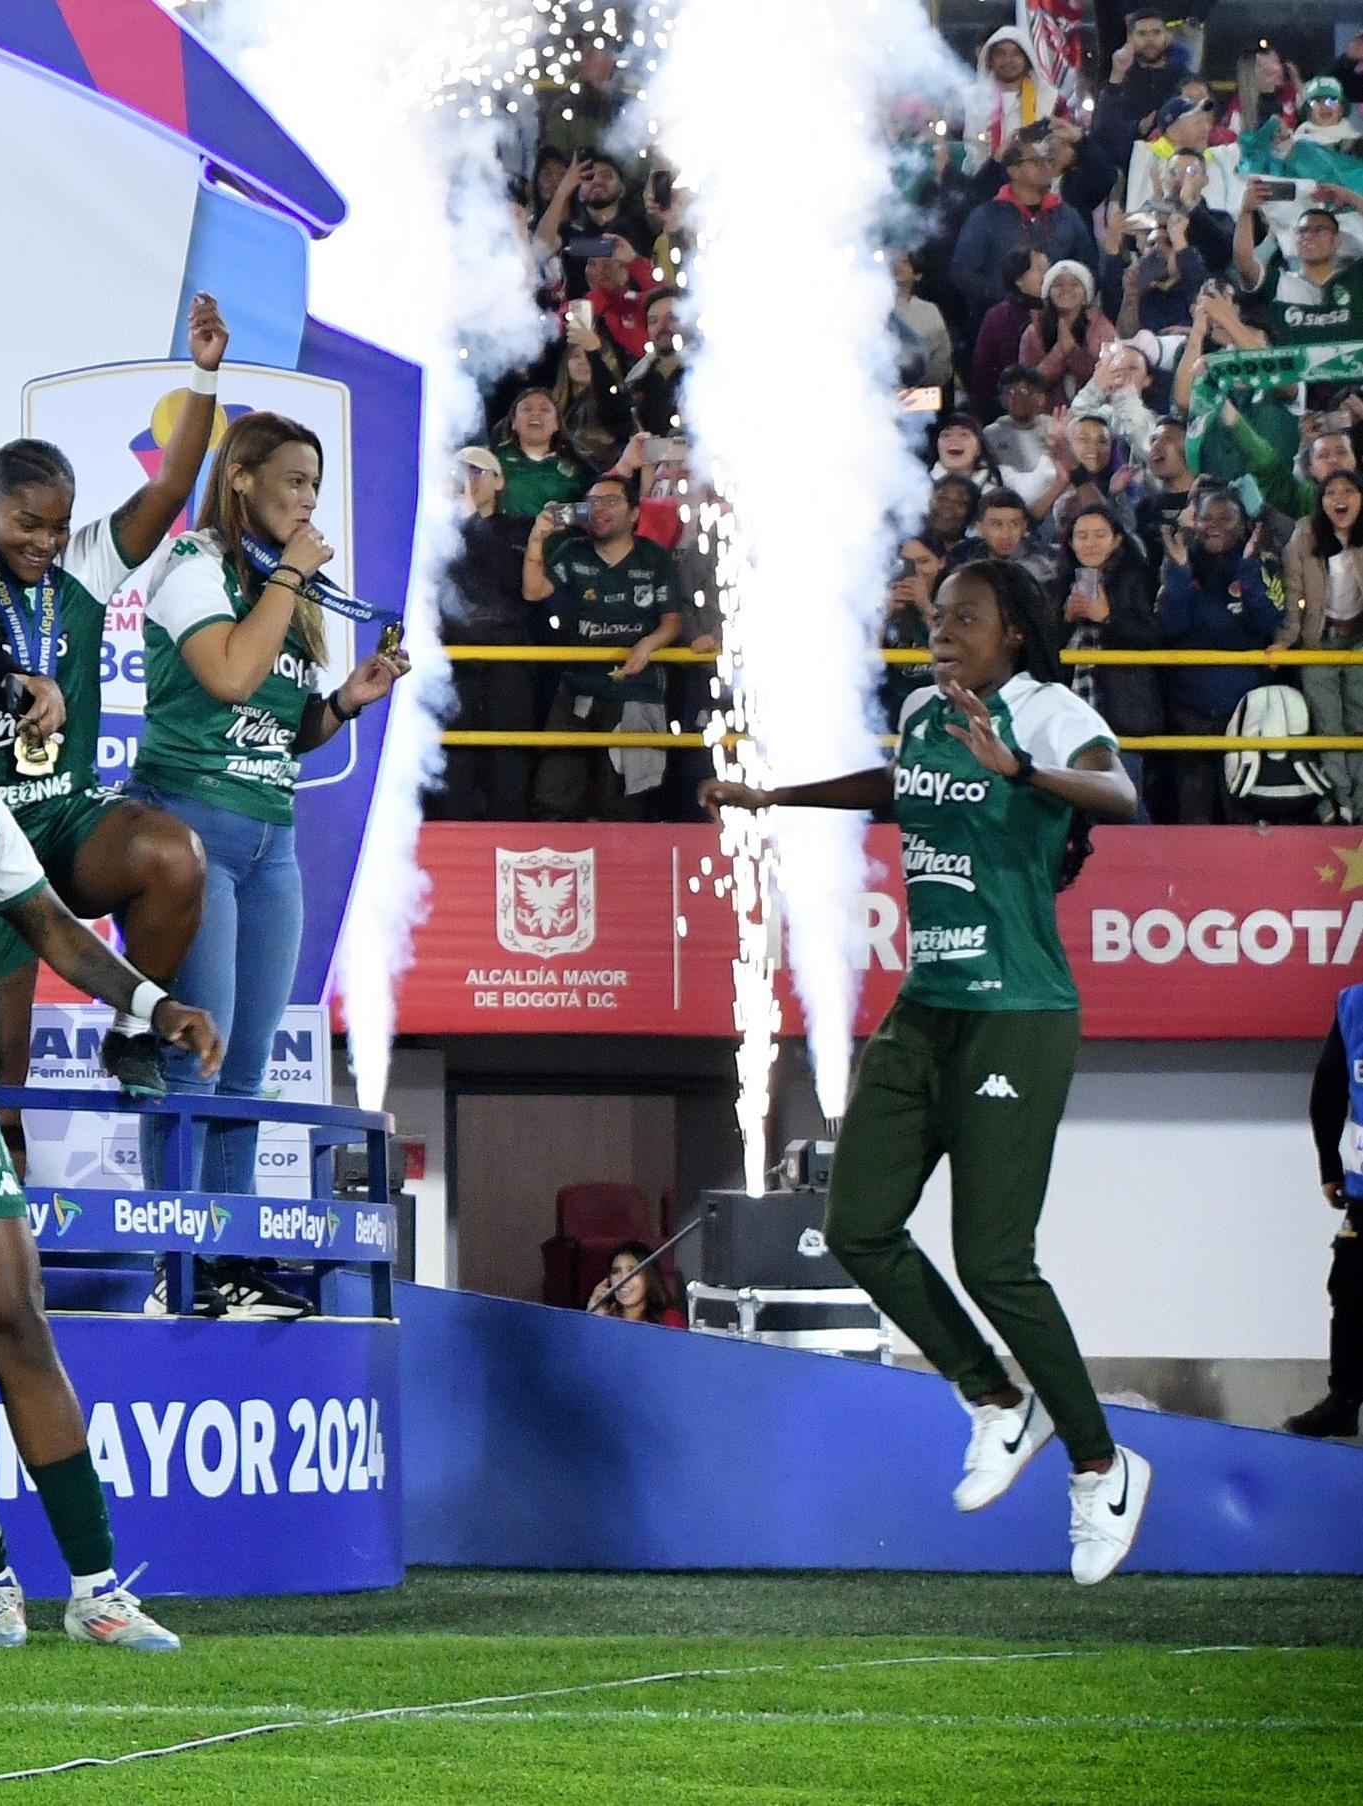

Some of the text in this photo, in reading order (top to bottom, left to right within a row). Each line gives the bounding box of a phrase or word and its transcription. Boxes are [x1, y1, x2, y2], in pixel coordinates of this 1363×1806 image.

[1303, 308, 1350, 327] siesa
[231, 704, 262, 719] PASTAS
[465, 966, 628, 986] ALCALDÍA MAYOR
[474, 992, 499, 1008] DE
[587, 992, 618, 1008] D.C.
[269, 1068, 313, 1082] 2024
[258, 1152, 299, 1167] COP
[114, 1198, 208, 1244] BetPlay
[259, 1205, 327, 1249] BetPlay
[288, 1397, 386, 1491] 2024
